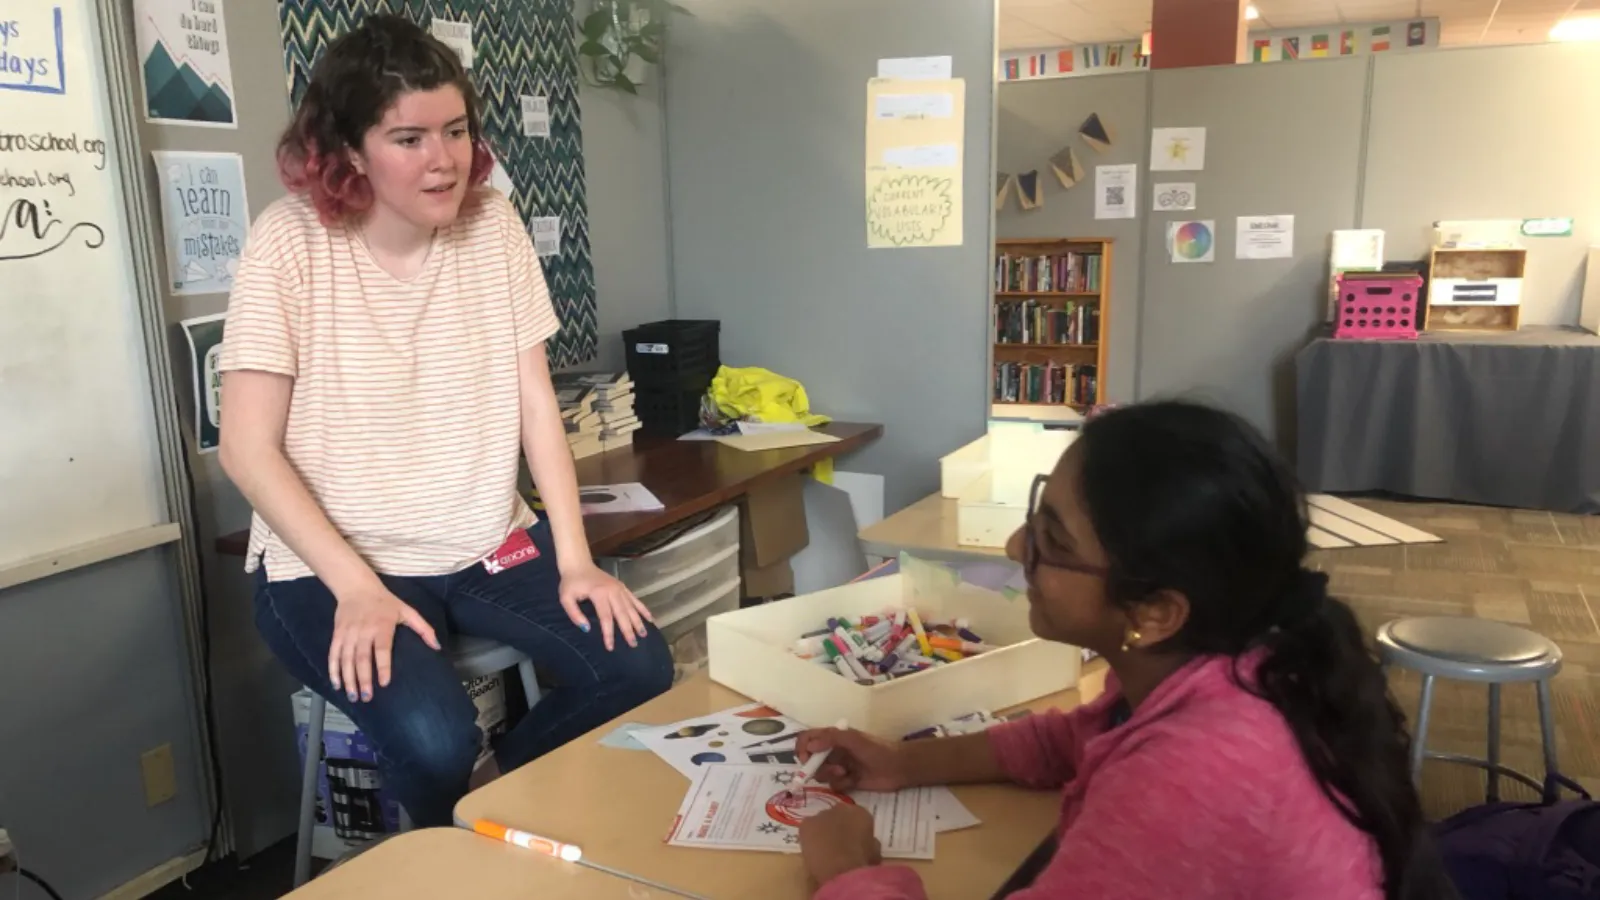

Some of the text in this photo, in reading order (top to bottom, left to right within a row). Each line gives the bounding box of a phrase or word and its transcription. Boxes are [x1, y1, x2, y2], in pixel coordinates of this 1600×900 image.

[200, 166, 219, 185] can
[176, 186, 231, 217] learn
[184, 233, 241, 260] mistakes
[470, 677, 499, 700] Beach
